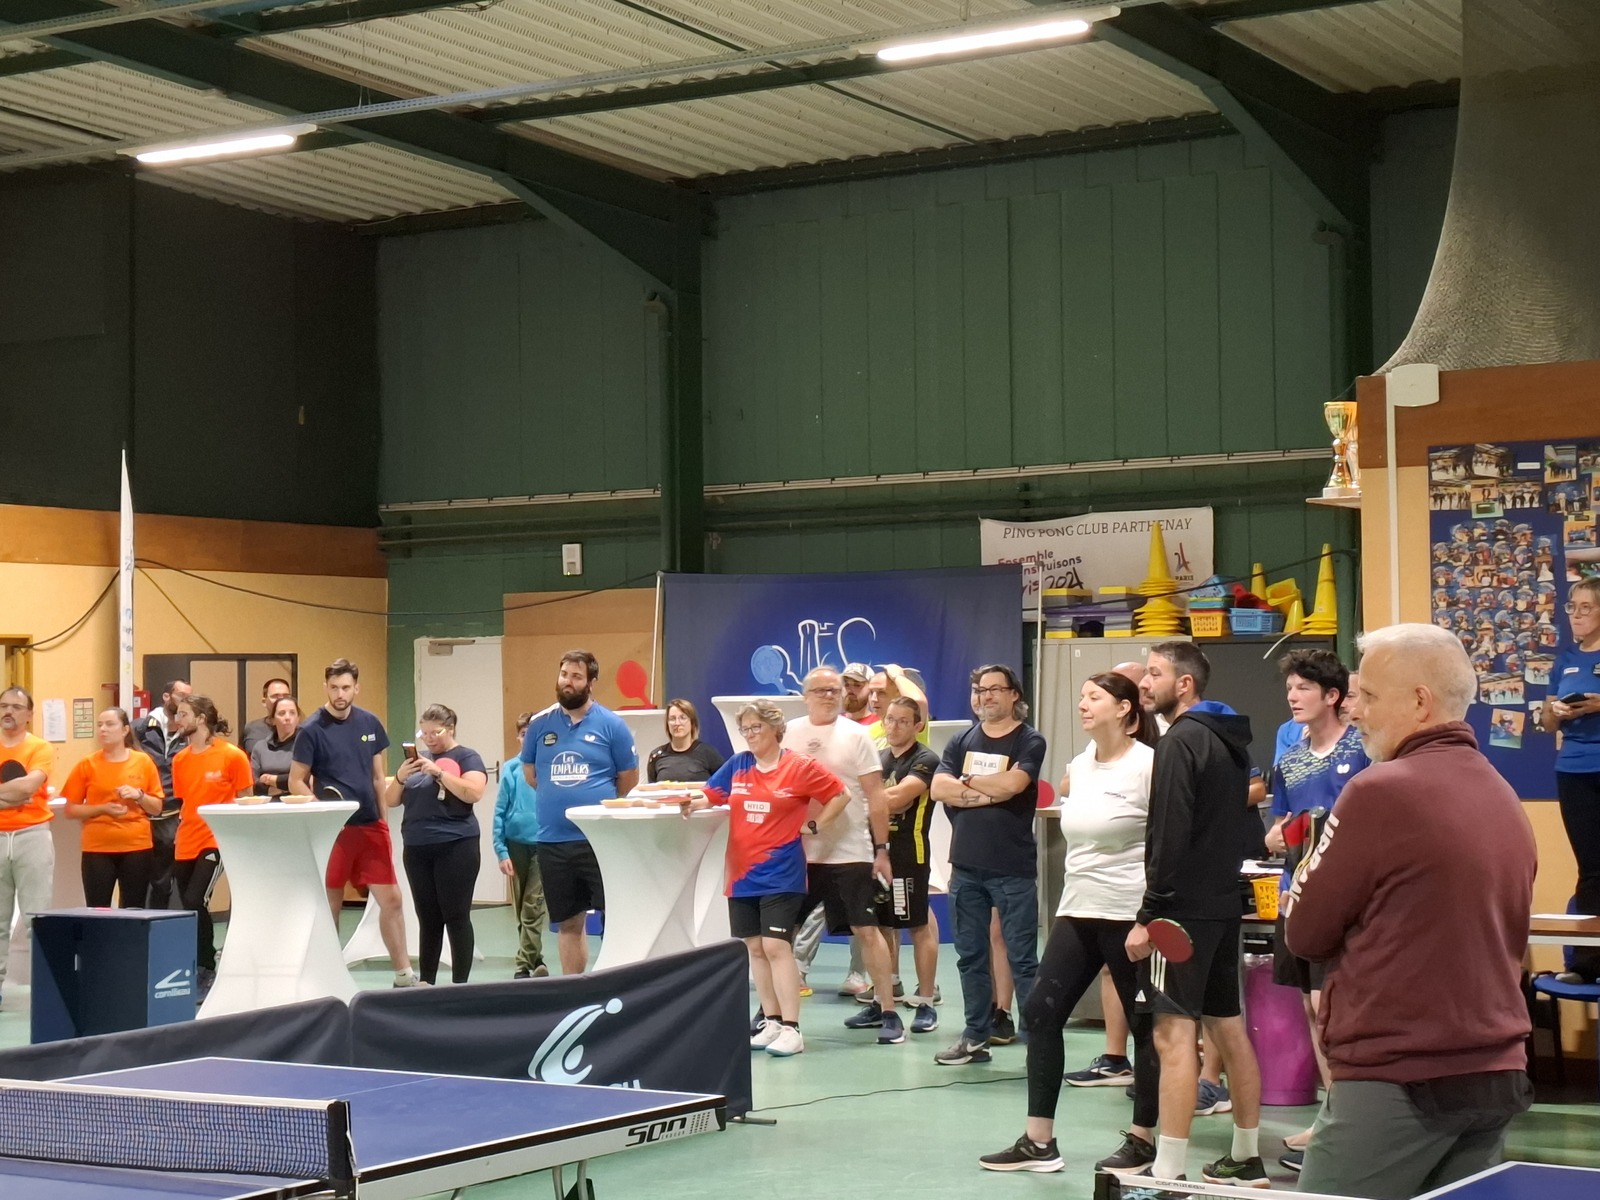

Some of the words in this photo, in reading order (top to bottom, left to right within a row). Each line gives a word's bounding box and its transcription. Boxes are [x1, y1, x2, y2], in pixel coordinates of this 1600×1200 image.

[1003, 527, 1036, 539] PING
[1039, 525, 1074, 538] PONG
[1076, 522, 1109, 535] CLUB
[1112, 518, 1192, 533] PARTHENAY
[893, 878, 906, 915] PUMA
